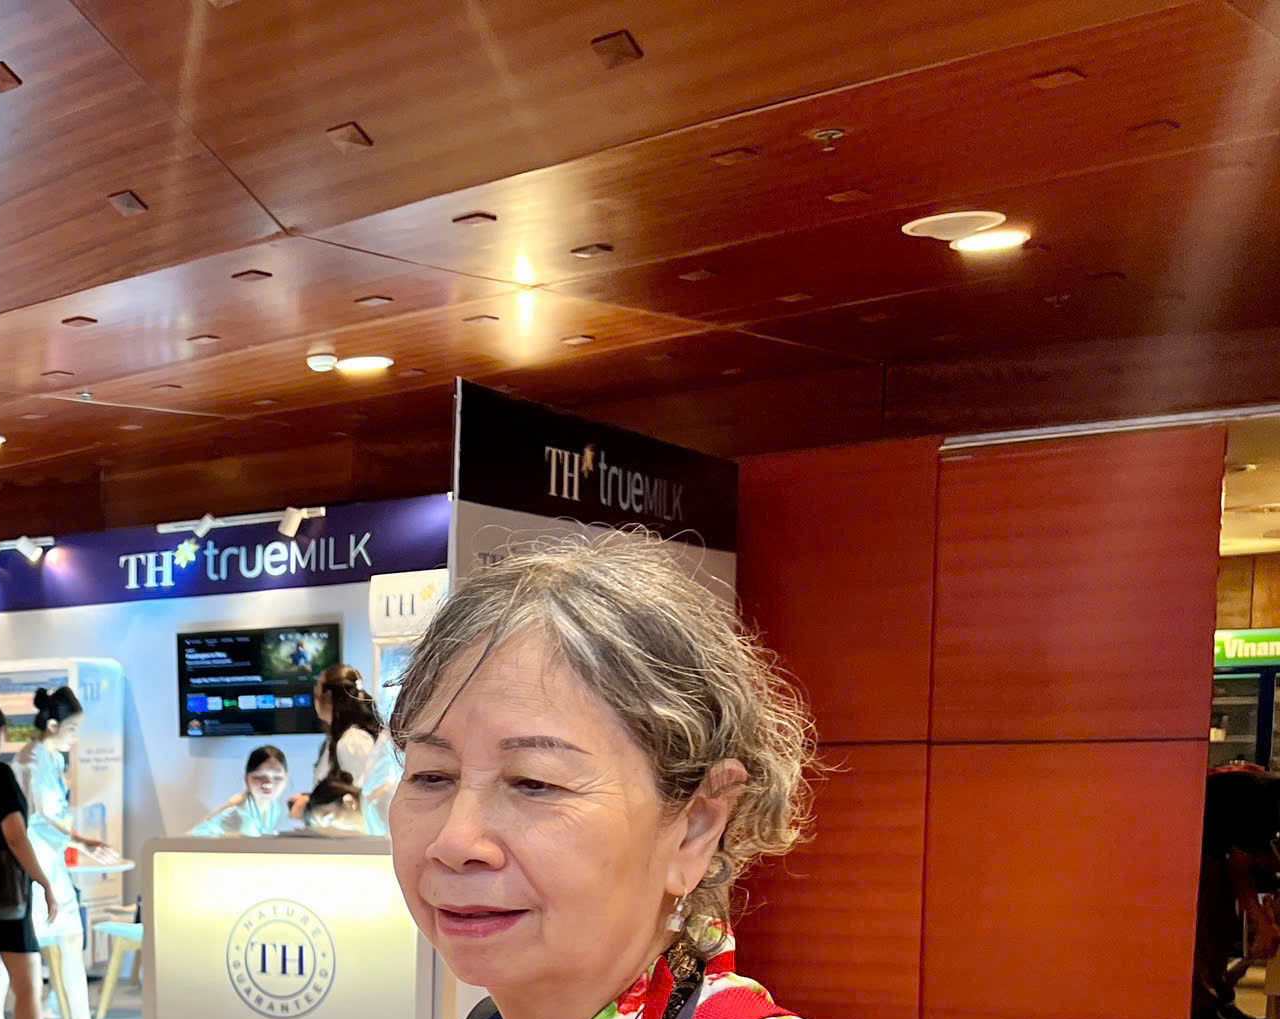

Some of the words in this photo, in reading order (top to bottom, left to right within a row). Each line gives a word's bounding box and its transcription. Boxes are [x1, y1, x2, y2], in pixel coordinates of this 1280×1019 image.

[545, 446, 580, 501] TH
[119, 551, 177, 590] TH
[242, 904, 322, 939] NATURE
[250, 943, 305, 976] TH
[232, 959, 329, 1014] GUARANTEED
